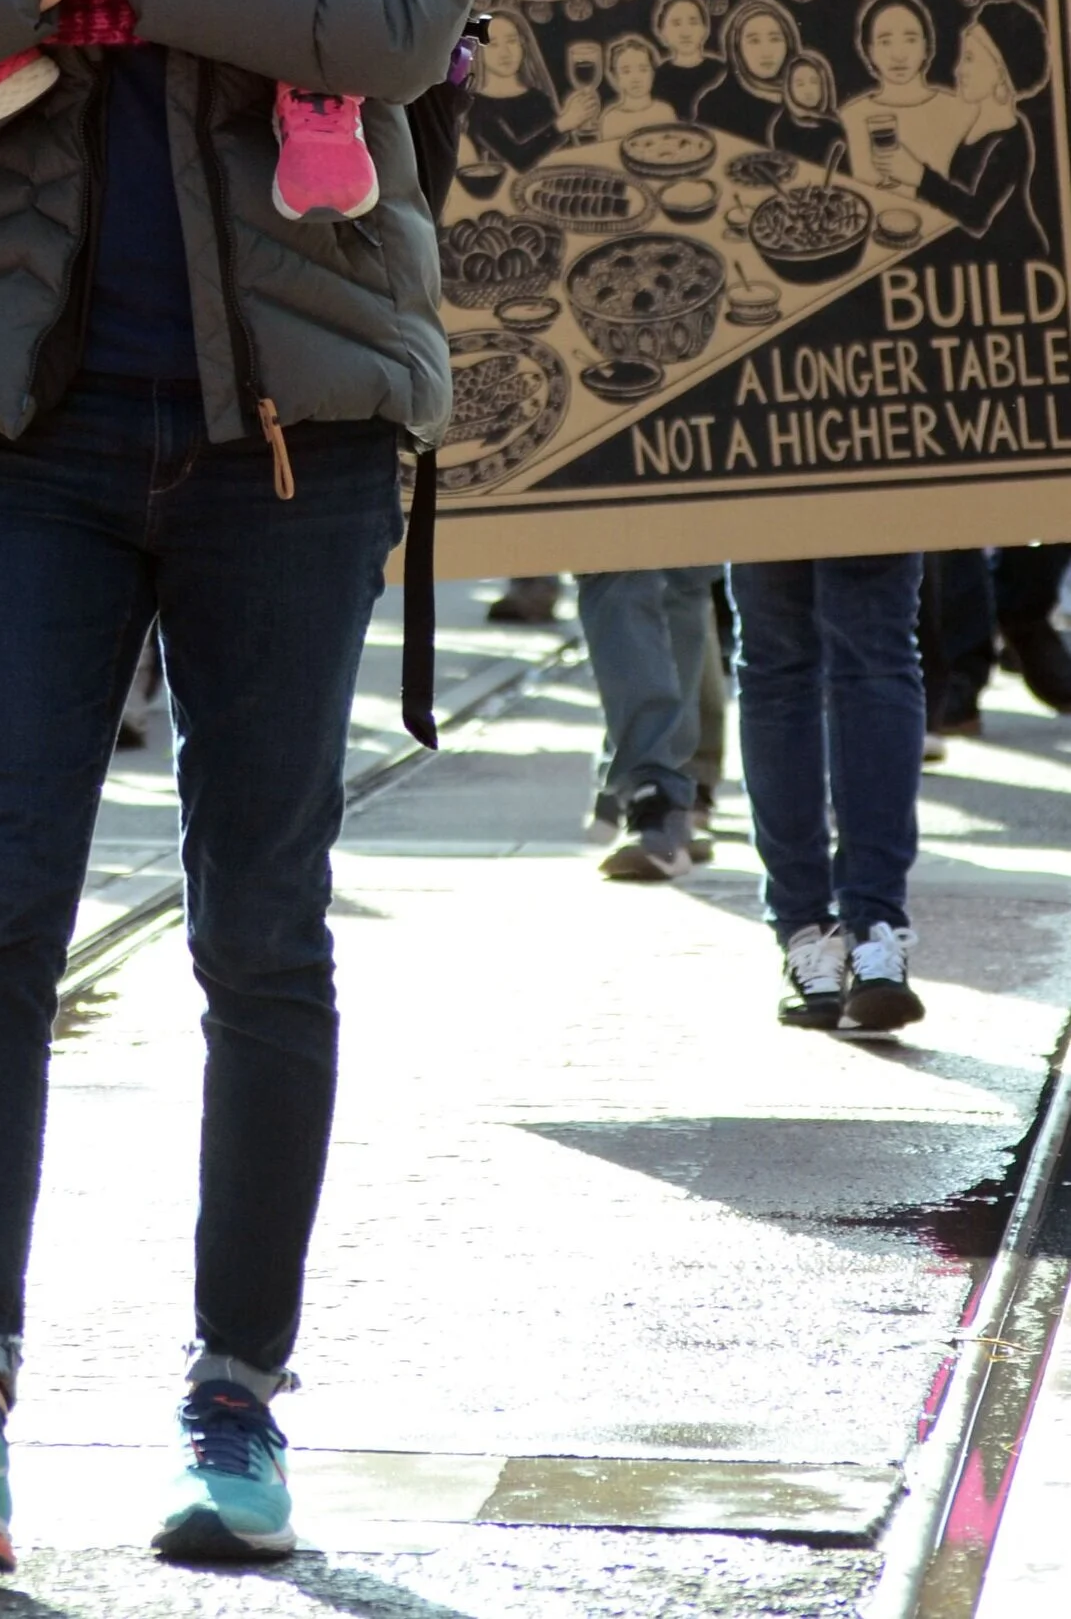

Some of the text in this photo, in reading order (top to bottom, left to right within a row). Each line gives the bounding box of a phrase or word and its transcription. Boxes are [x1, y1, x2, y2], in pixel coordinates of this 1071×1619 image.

[880, 258, 1068, 332] BUILD
[736, 328, 1071, 408] A LONGER TABLE
[631, 392, 1071, 477] NOT A HIGHER WALL
